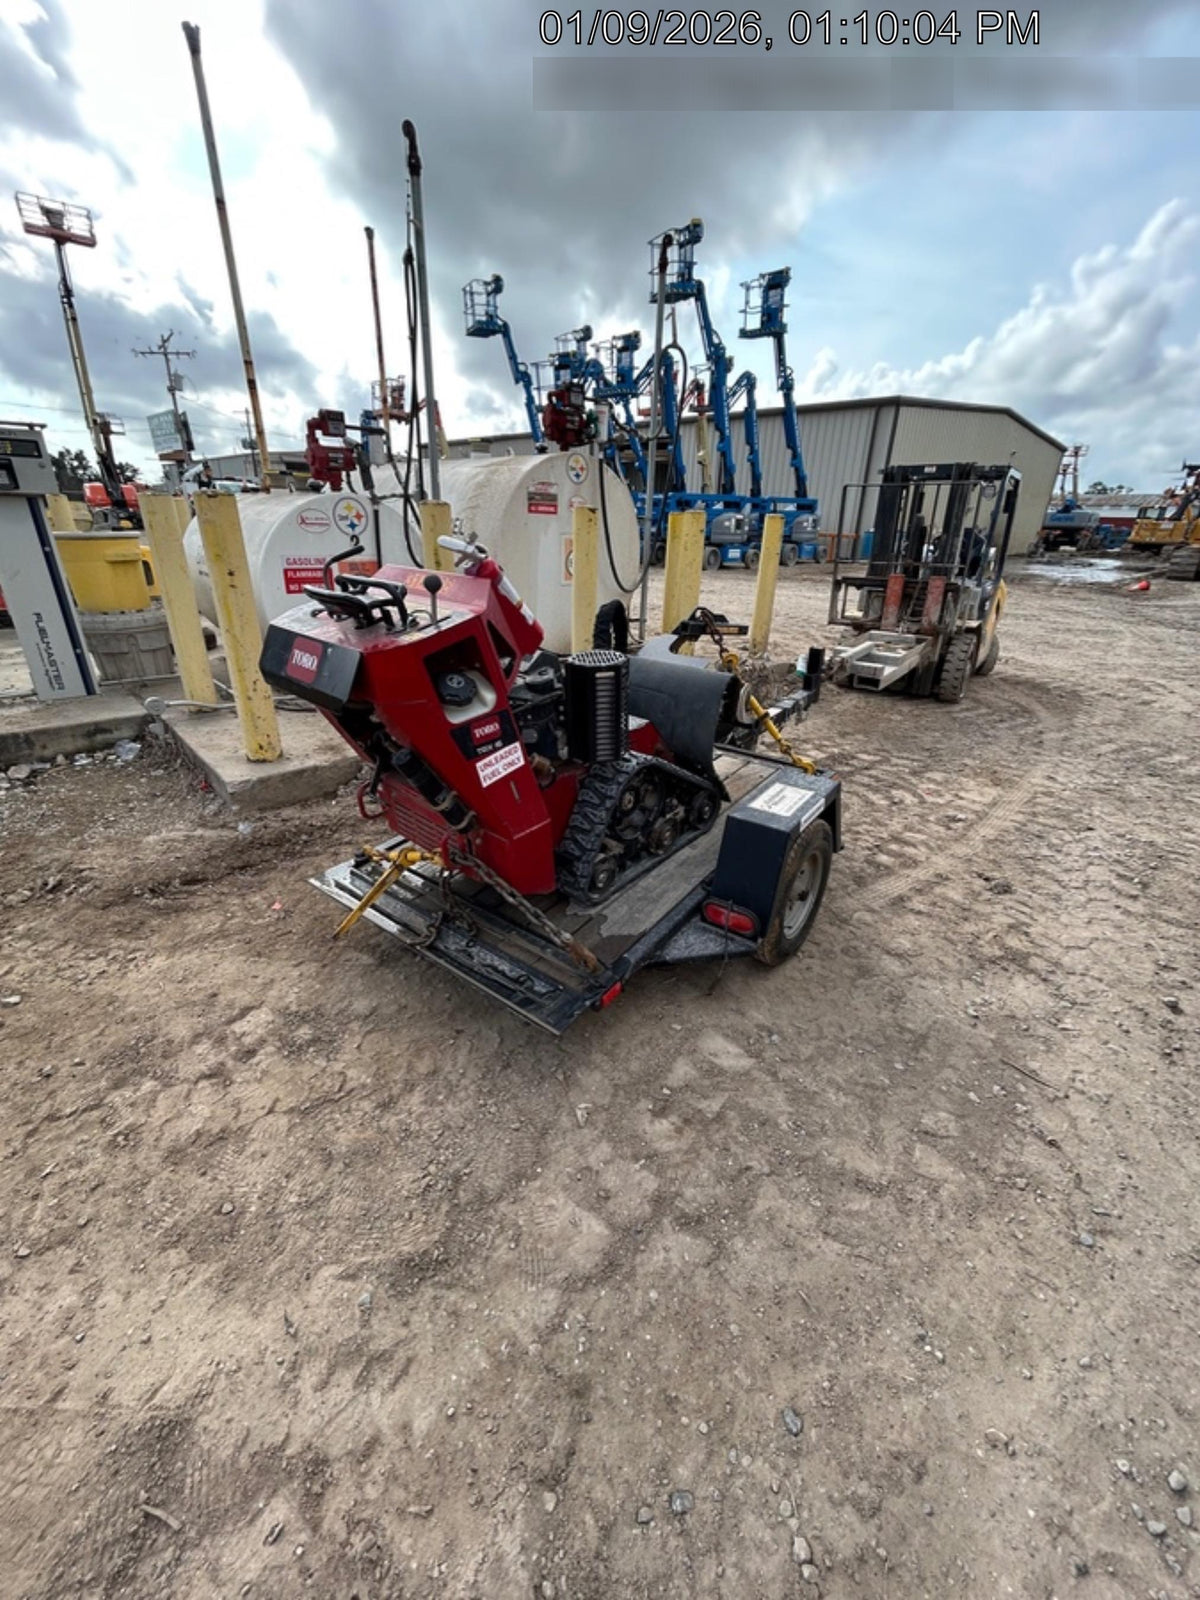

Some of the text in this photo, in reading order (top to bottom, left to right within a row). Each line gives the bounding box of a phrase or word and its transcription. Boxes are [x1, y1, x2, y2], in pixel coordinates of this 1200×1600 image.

[285, 557, 326, 567] GASOLIN
[32, 612, 65, 691] FUELMASTER
[291, 648, 318, 672] TORO
[473, 721, 500, 739] TORO
[479, 745, 520, 773] UNLEADED
[482, 756, 522, 783] FUEL ONLY
